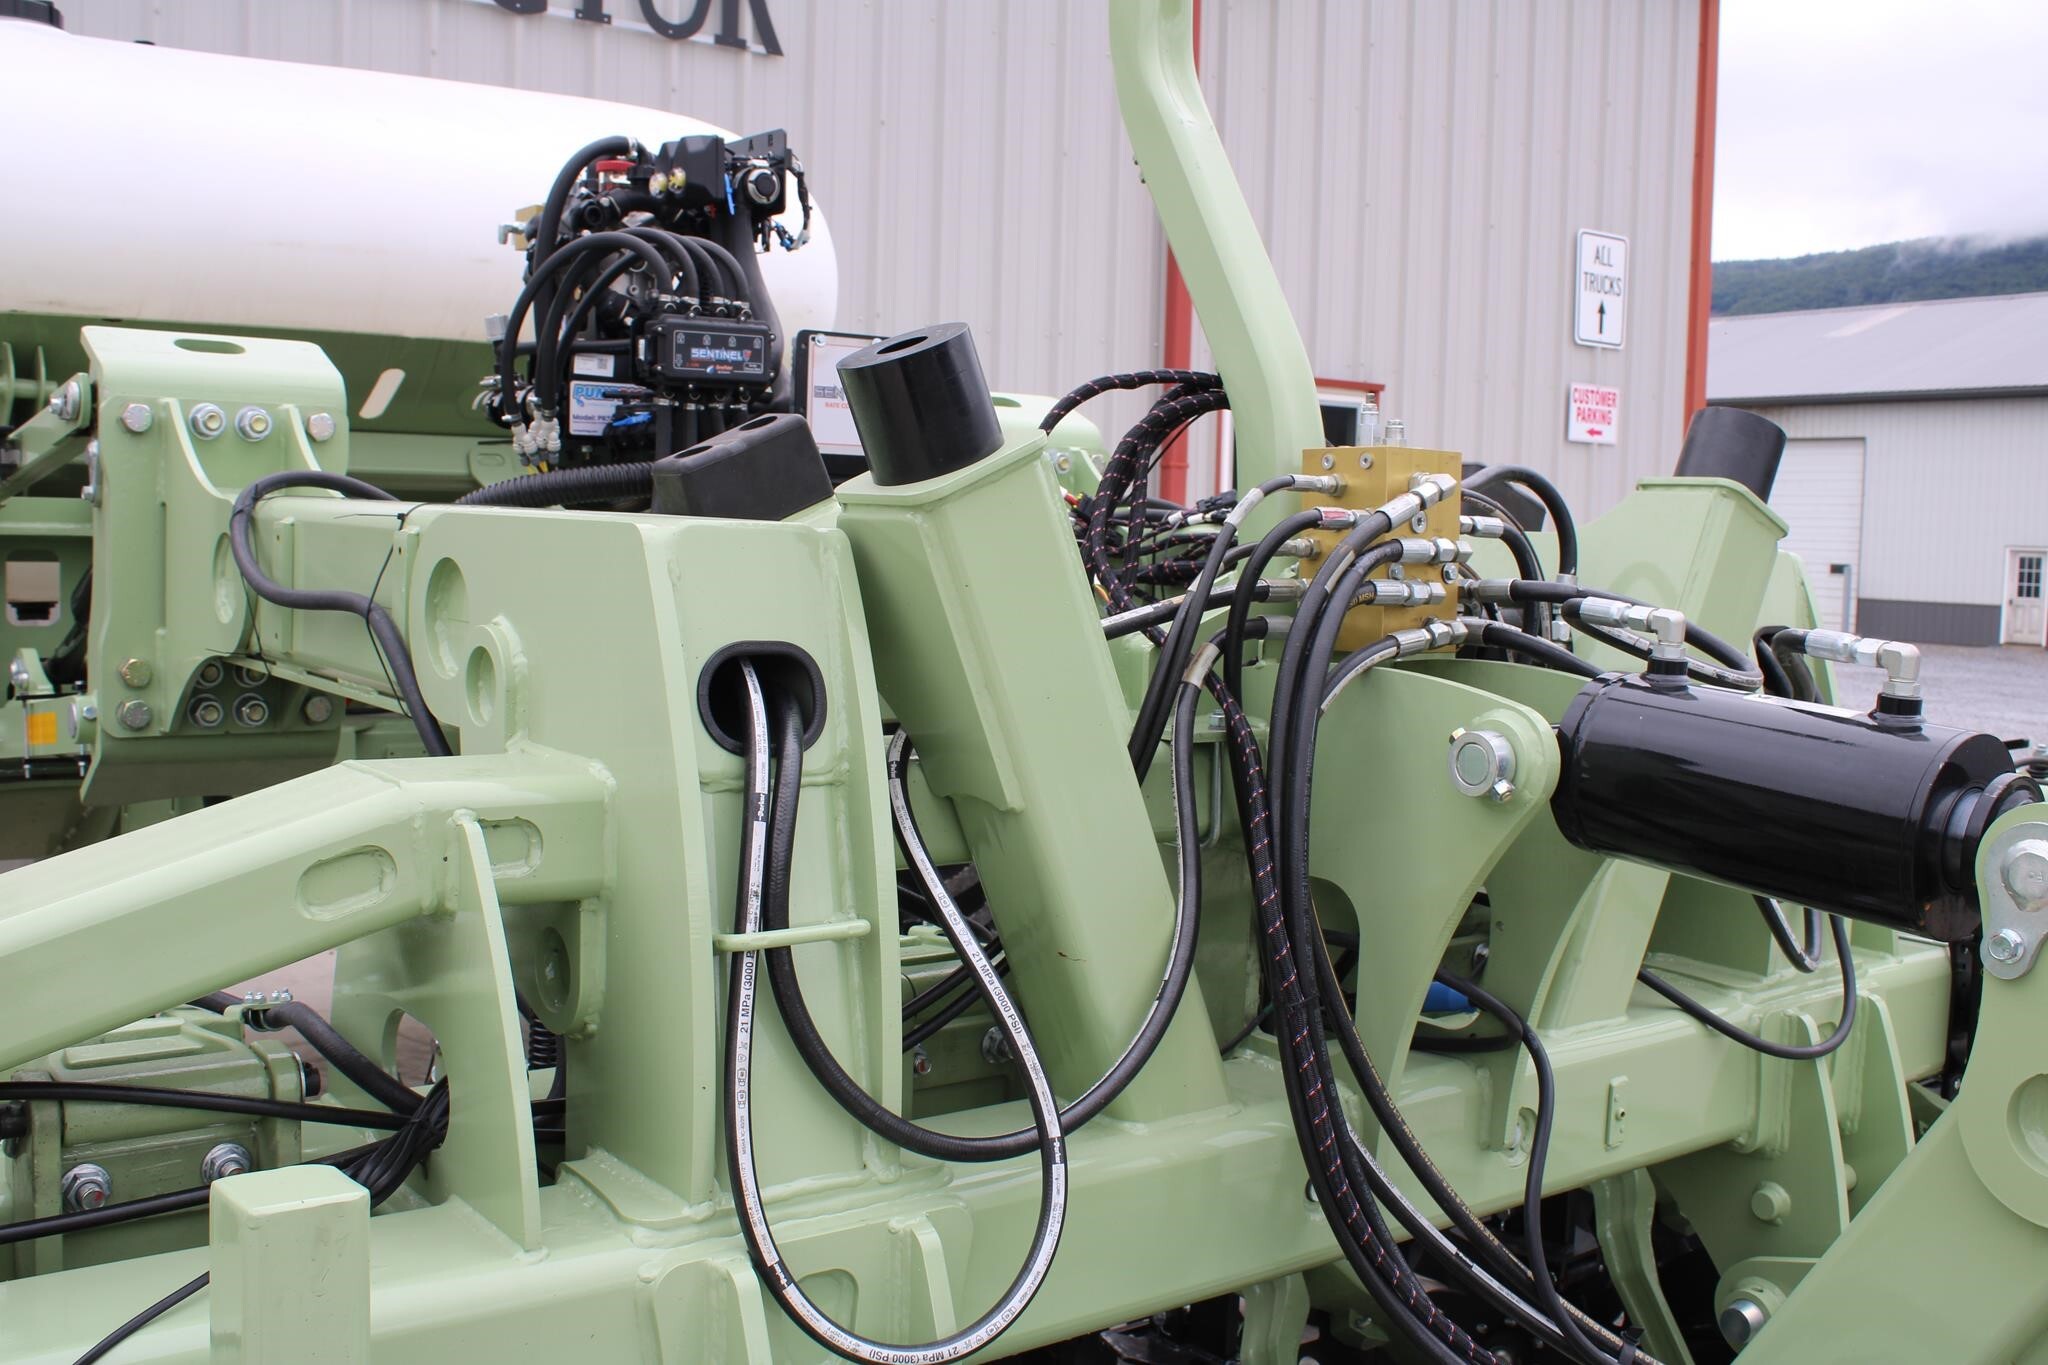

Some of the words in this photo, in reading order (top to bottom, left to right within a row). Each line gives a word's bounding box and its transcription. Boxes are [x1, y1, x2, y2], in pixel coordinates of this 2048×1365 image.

[1593, 245, 1613, 267] ALL
[1583, 271, 1622, 297] TRUCKS
[690, 347, 744, 361] SENTINEL
[1573, 387, 1616, 408] CUSTOMER
[1577, 406, 1612, 426] PARKING
[743, 961, 754, 991] (3000
[971, 950, 982, 963] 21
[979, 963, 995, 985] MPa
[992, 986, 1012, 1013] (3000
[1007, 1013, 1023, 1034] PSI)
[741, 993, 752, 1018] MPa
[740, 1021, 749, 1034] 21
[867, 1347, 890, 1362] PSI)
[891, 1353, 920, 1364] (3000
[921, 1349, 945, 1364] MPa
[946, 1345, 959, 1357] 21
